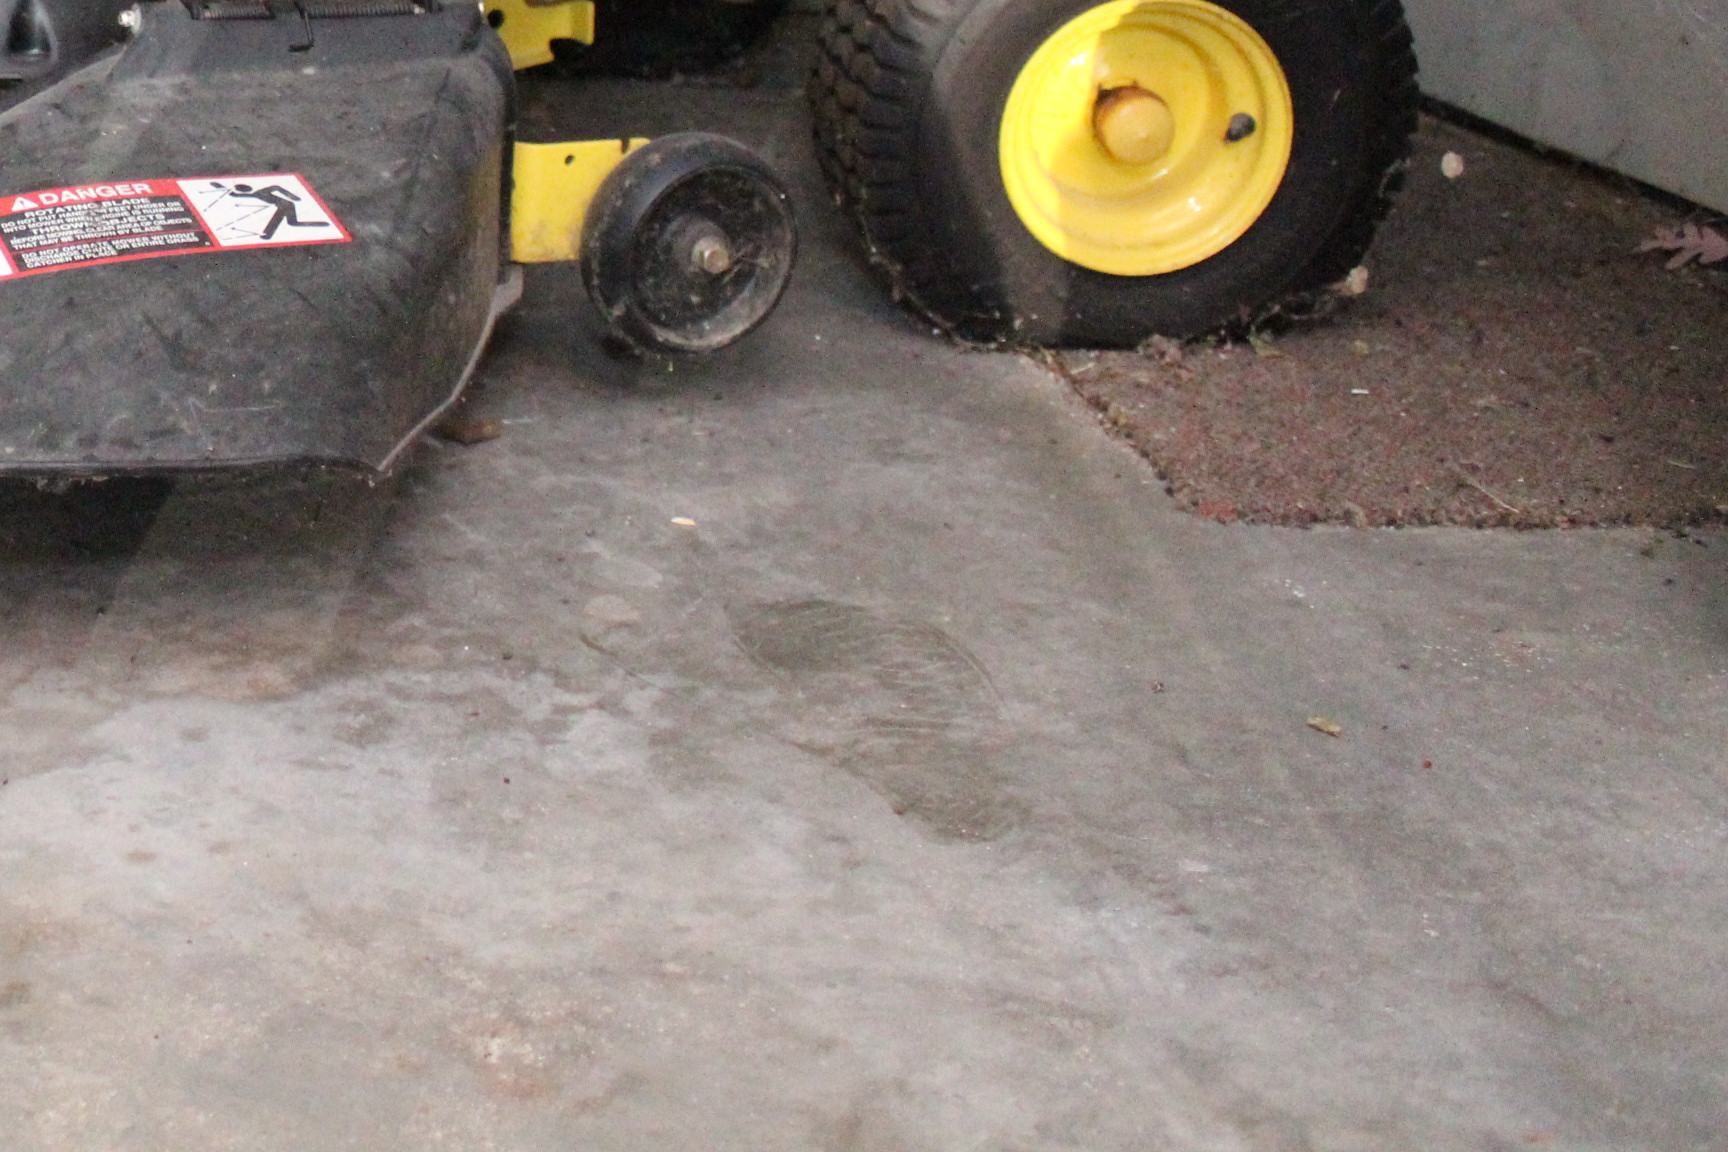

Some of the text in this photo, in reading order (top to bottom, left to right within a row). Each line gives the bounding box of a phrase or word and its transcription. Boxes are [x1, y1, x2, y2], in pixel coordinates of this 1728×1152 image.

[38, 183, 153, 204] DANGER
[24, 198, 150, 218] ROTATING BLADE
[3, 225, 26, 233] INTO
[28, 219, 64, 228] MOWER
[17, 218, 36, 226] NOT
[38, 214, 56, 222] PUT
[10, 236, 45, 245] BEFORE
[13, 242, 37, 250] THAT
[39, 238, 58, 246] MAY
[76, 231, 116, 240] THROWN
[132, 225, 164, 234] BLADE
[63, 241, 109, 252] OPERATE
[112, 236, 149, 245] MOWER
[151, 232, 195, 240] WITHOUT
[26, 257, 72, 268] CATCHER
[86, 250, 117, 259] PLACE
